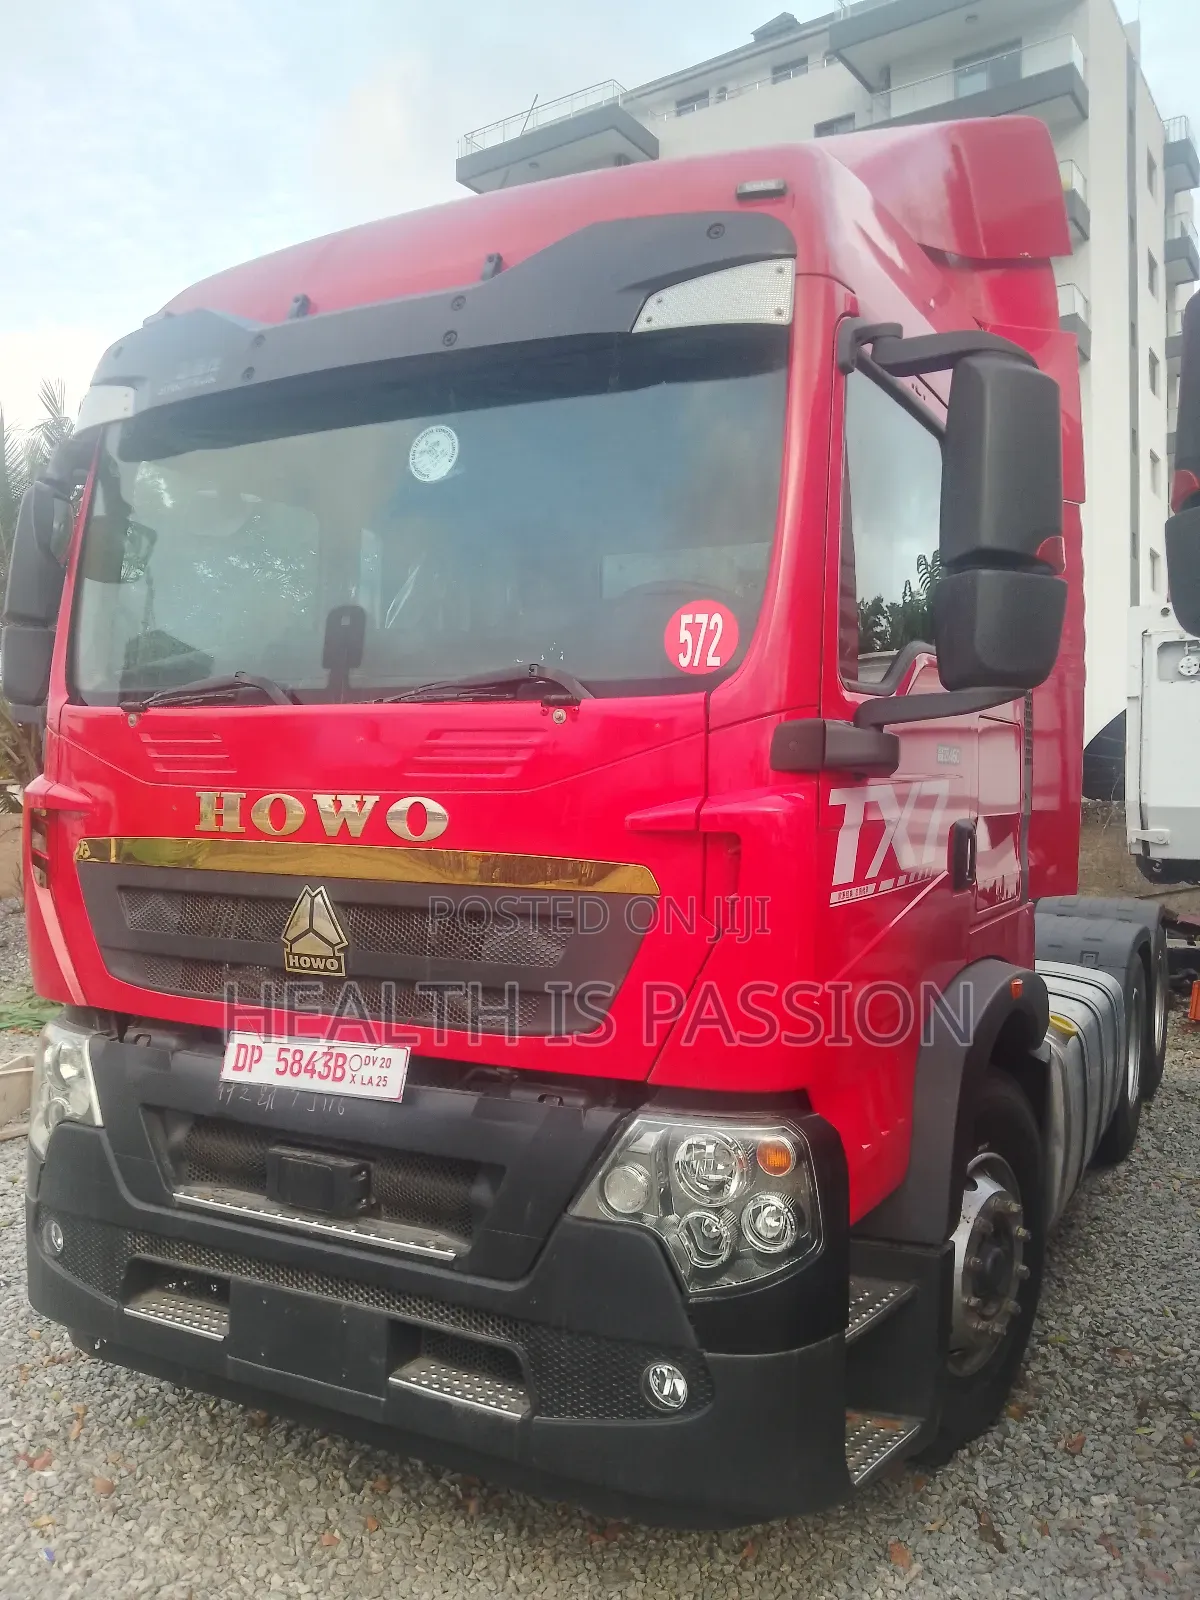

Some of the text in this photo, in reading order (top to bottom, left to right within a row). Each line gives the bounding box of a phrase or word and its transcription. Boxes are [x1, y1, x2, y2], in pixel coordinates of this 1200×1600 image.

[678, 612, 723, 668] 572
[195, 791, 449, 842] HOWO
[288, 955, 340, 972] HOWO
[232, 1043, 348, 1083] DP 5843B
[379, 1056, 392, 1069] 20
[360, 1075, 374, 1086] LA
[375, 1075, 388, 1087] 25
